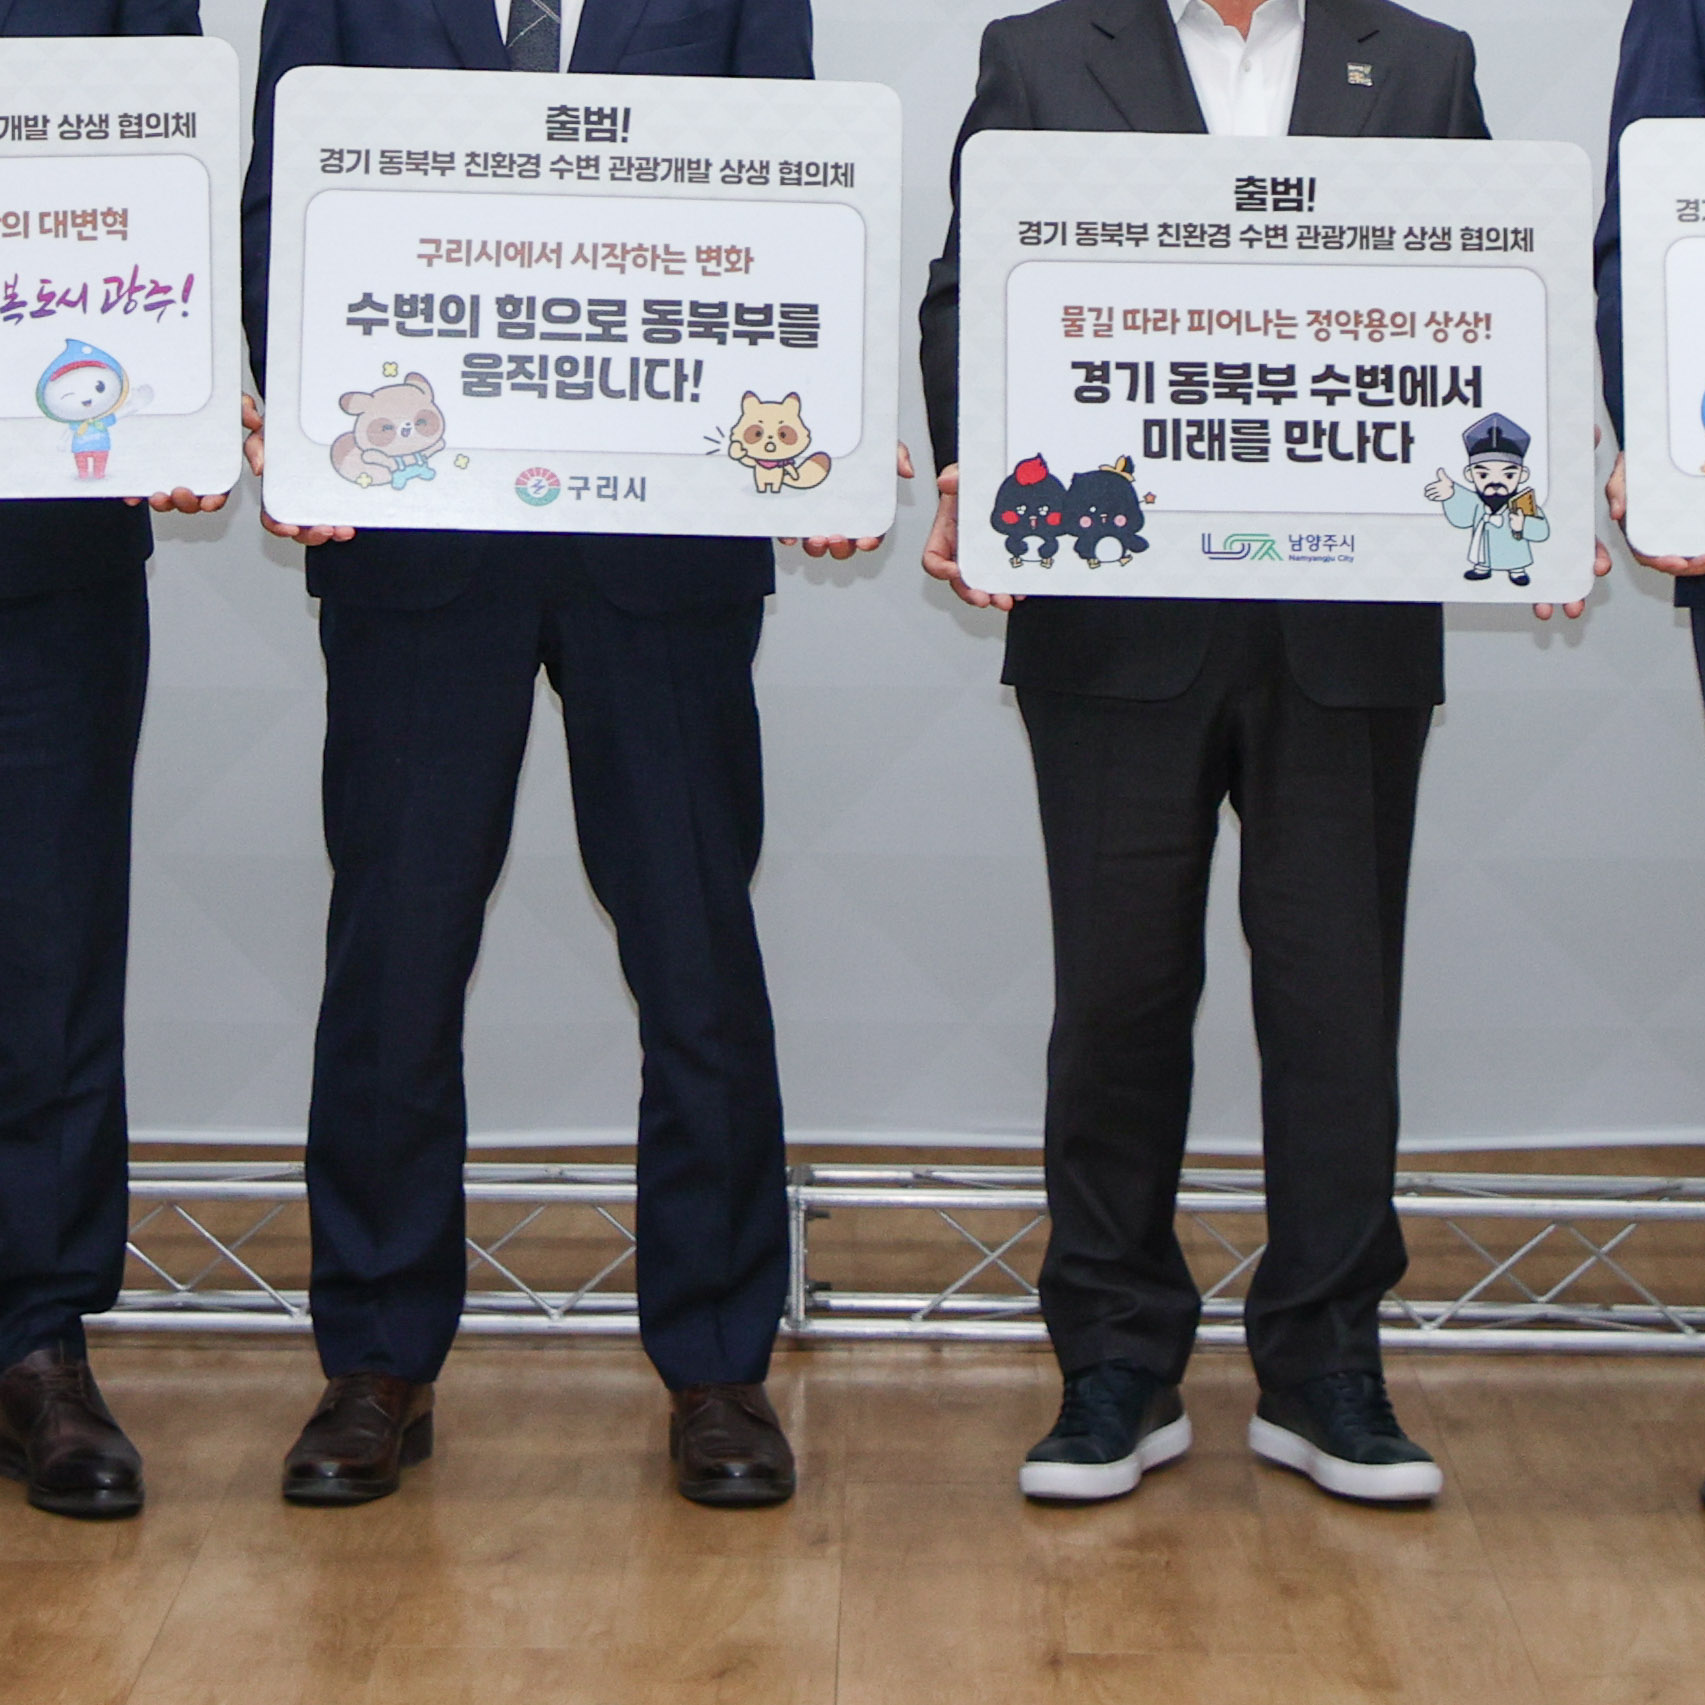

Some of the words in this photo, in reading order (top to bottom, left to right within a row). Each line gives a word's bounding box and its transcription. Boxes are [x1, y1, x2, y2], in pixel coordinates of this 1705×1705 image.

[58, 114, 109, 140] 상생
[118, 112, 196, 139] 협의체
[546, 105, 630, 143] 출범!
[320, 149, 370, 174] 경기
[379, 150, 455, 176] 동북부
[465, 152, 540, 178] 친환경
[550, 155, 600, 180] 수변
[609, 156, 712, 183] 관광개발
[720, 159, 769, 185] 상생
[779, 160, 854, 187] 협의체
[1234, 176, 1315, 212] 출범!
[39, 207, 128, 241] 대변혁
[1019, 221, 1066, 246] 경기
[1075, 222, 1149, 247] 동북부
[1158, 222, 1230, 248] 친환경
[1240, 225, 1288, 249] 수변
[1296, 225, 1396, 250] 관광개발
[1404, 227, 1451, 251] 상생
[1461, 227, 1533, 252] 협의체
[417, 238, 562, 269] 구리시에서
[571, 243, 687, 275] 시작하는
[696, 245, 754, 276] 변화
[101, 264, 194, 322] 광주!
[346, 292, 480, 338] 수변의
[496, 294, 628, 342] 힘으로
[642, 299, 820, 348] 동북부를
[1062, 306, 1113, 338] 물길
[1123, 308, 1180, 335] 따라
[1188, 309, 1298, 339] 피어나는
[1307, 308, 1415, 342] 정약용의
[1424, 311, 1491, 343] 상상!
[461, 353, 703, 402] 움직입니다!
[1071, 361, 1154, 403] 경기
[1169, 362, 1297, 405] 동북부
[1311, 364, 1482, 408] 수변에서
[1143, 418, 1271, 462] 미래를
[1285, 420, 1414, 463] 만나다
[568, 476, 646, 502] 구리시
[1289, 535, 1354, 552] 남양주시
